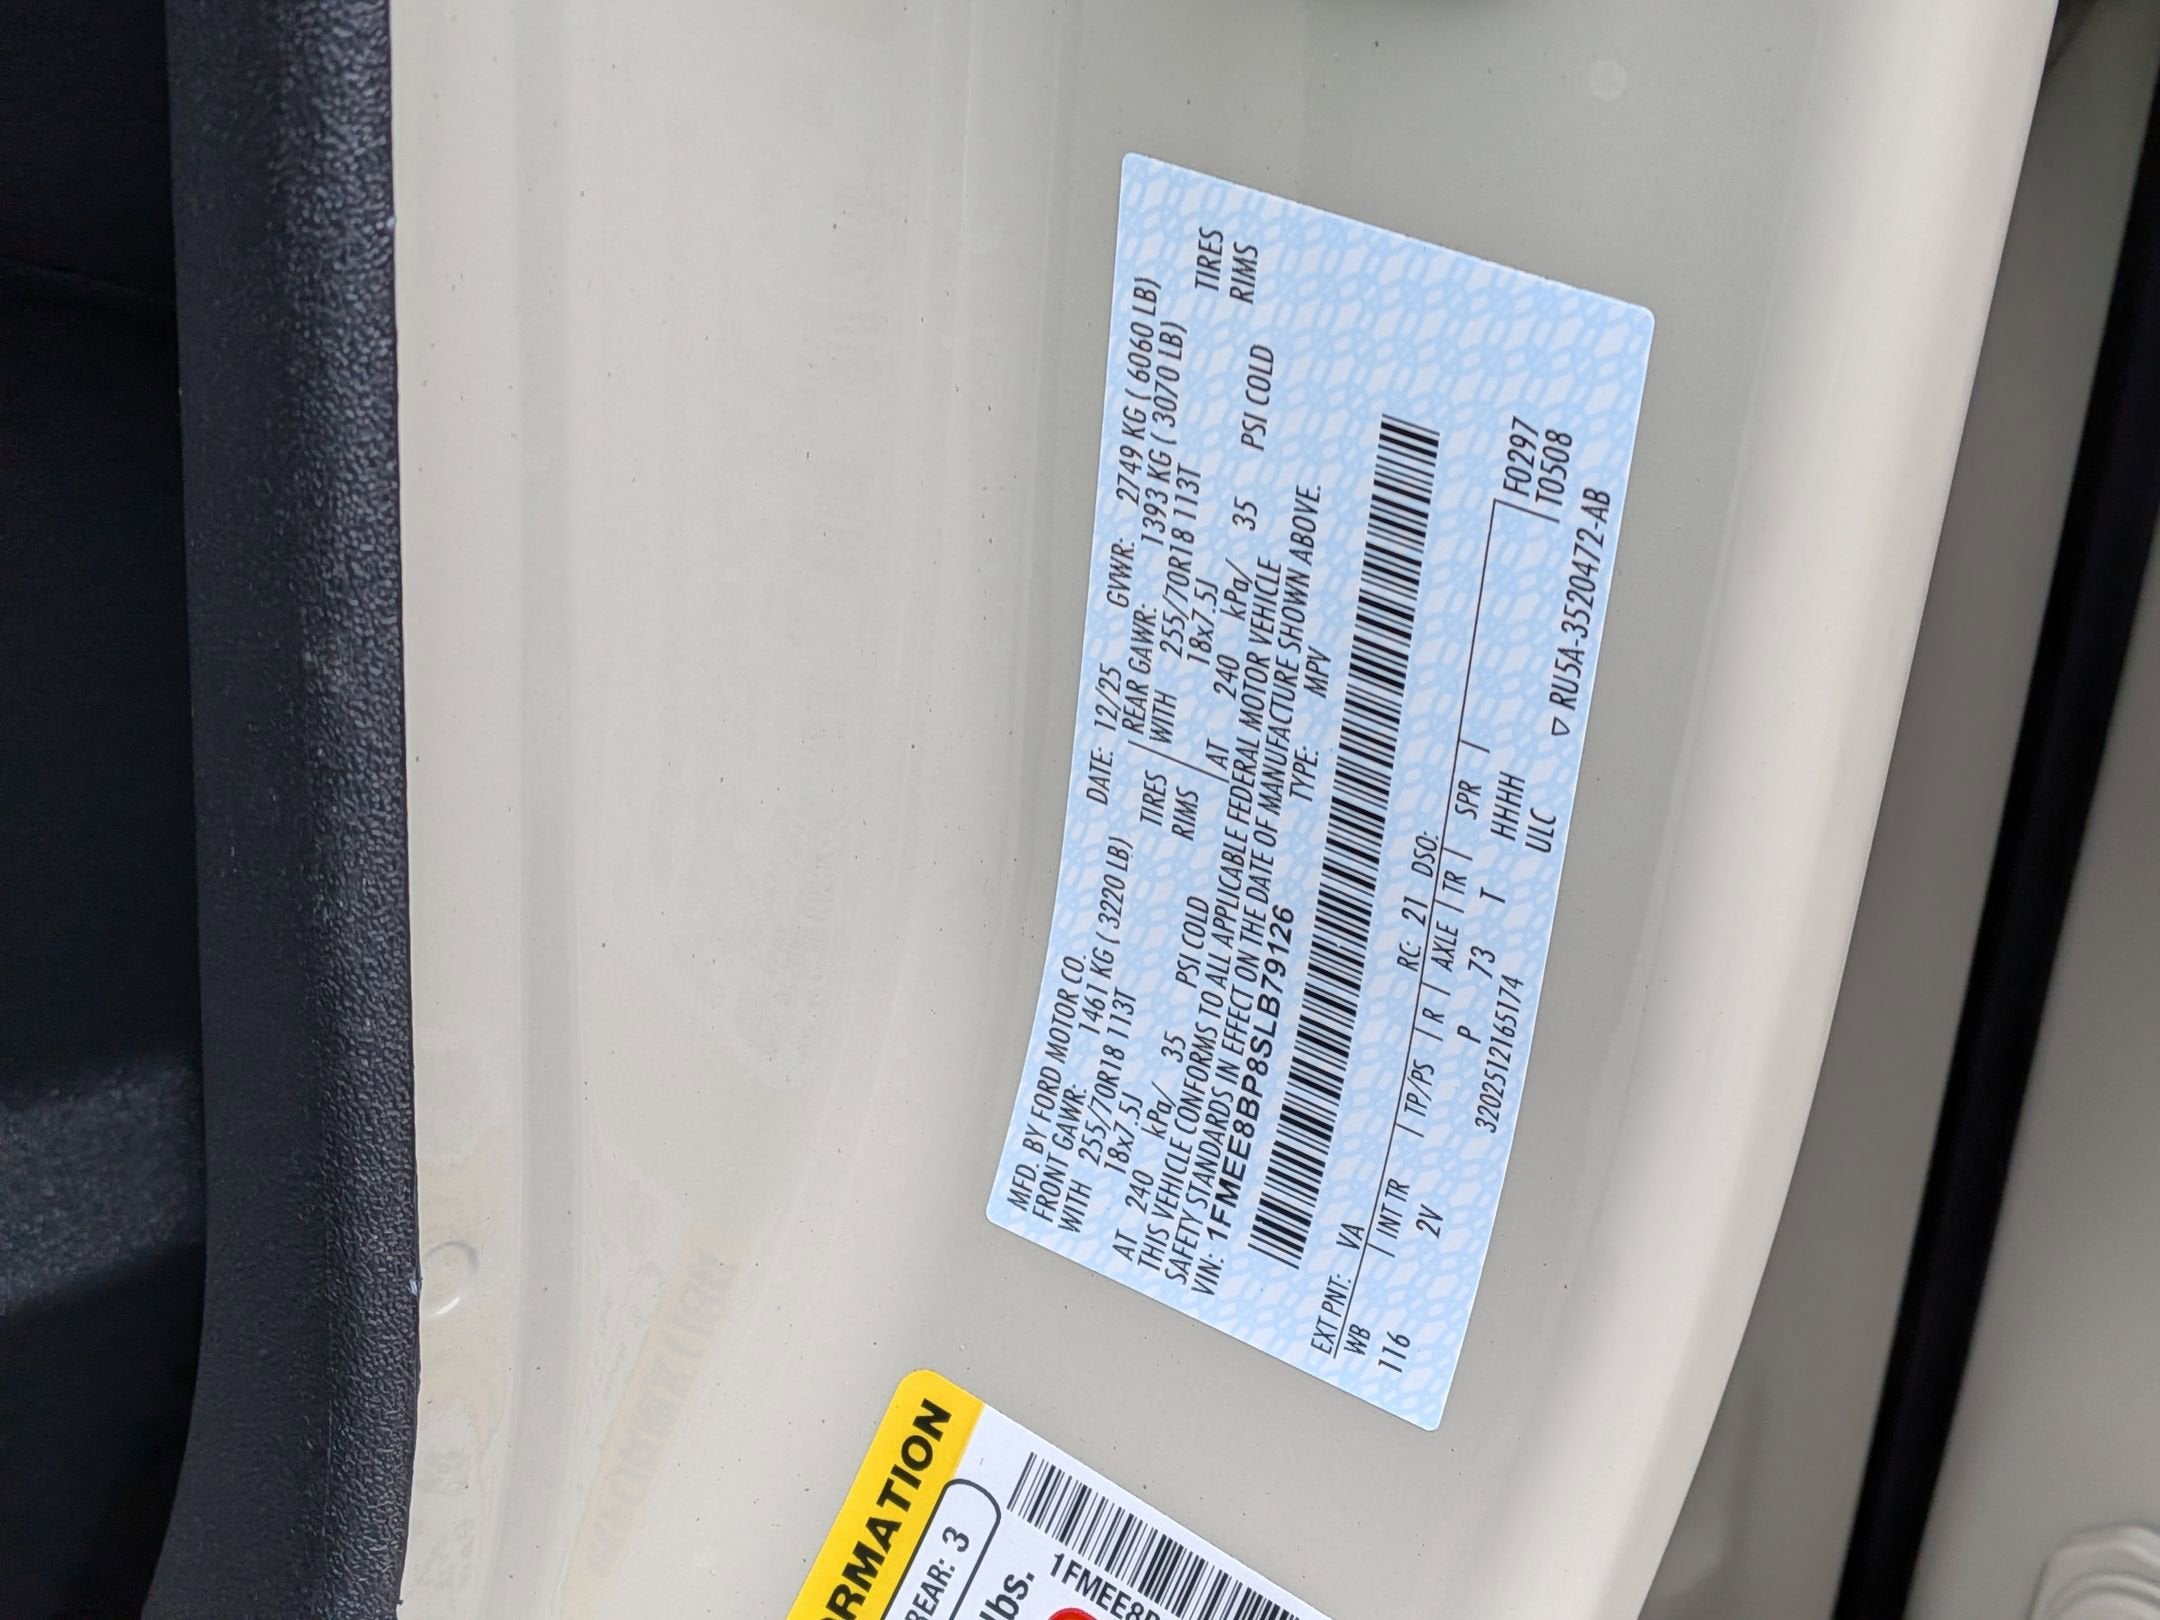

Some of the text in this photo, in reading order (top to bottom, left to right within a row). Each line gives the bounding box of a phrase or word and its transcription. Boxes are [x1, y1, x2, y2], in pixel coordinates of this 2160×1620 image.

[1132, 277, 1162, 317] LB)
[1126, 321, 1155, 384] 6060
[1157, 321, 1188, 361] LB)
[1121, 405, 1147, 441] KG
[1151, 365, 1180, 428] 3070
[1115, 445, 1144, 507] 2749
[1146, 448, 1172, 484] KG
[1148, 226, 1224, 745] WITH 255/70R18 113T TIRES
[1186, 241, 1259, 666] 18x7.5J RIMS
[1502, 415, 1539, 498] F0297
[1534, 429, 1573, 506] T0508
[1140, 487, 1169, 546] 1393
[1106, 538, 1135, 608] GVWR:
[1205, 344, 1274, 771] AT 240 kPa/ 35 PSI COLD
[1127, 603, 1157, 675] GAWR:
[1086, 662, 1122, 806] DATE: 12/25
[1121, 679, 1149, 735] REAR
[1474, 487, 1611, 1134] 3202512165174 ULC RU5A-3520472-AB
[1105, 836, 1134, 873] LB)
[1164, 484, 1321, 1285] SAFETY STANDARDS IN EFFECT ON THE DATE OF MANUFACTURE SHOWN ABOVE.
[1410, 830, 1439, 879] DSO:
[1097, 873, 1126, 930] 3220
[1137, 556, 1282, 1271] THIS VEHICLE CONFORMS TO ALL APPLICABLE FEDERAL MOTOR VEHICLE
[1401, 895, 1429, 928] 21
[1089, 946, 1115, 980] KG
[1103, 785, 1199, 1175] 18x7.5J RIMS
[1191, 645, 1332, 1296] VIN: 1FMEE8BP8SLB79126 TYPE: MPV
[1058, 769, 1168, 1233] WITH 255/70R18 113T TIRES
[1078, 983, 1108, 1035] 1461
[1007, 955, 1087, 1212] MFD. BY FORD MOTOR CO.
[1112, 895, 1210, 1262] AT 240 kPa/ 35 PSI COLD
[1343, 779, 1482, 1356] WB INT TR TP/PS R AXLE TR SPR
[1378, 770, 1526, 1373] 116 2V P 73 T HHHH
[1051, 1084, 1087, 1151] GAWR:
[1032, 1151, 1069, 1223] FRONT
[1335, 1223, 1365, 1250] VA
[1321, 1274, 1352, 1318] PNT:
[1310, 1315, 1338, 1355] EXT
[820, 1397, 953, 1620] RMATION
[941, 1526, 970, 1553] 3
